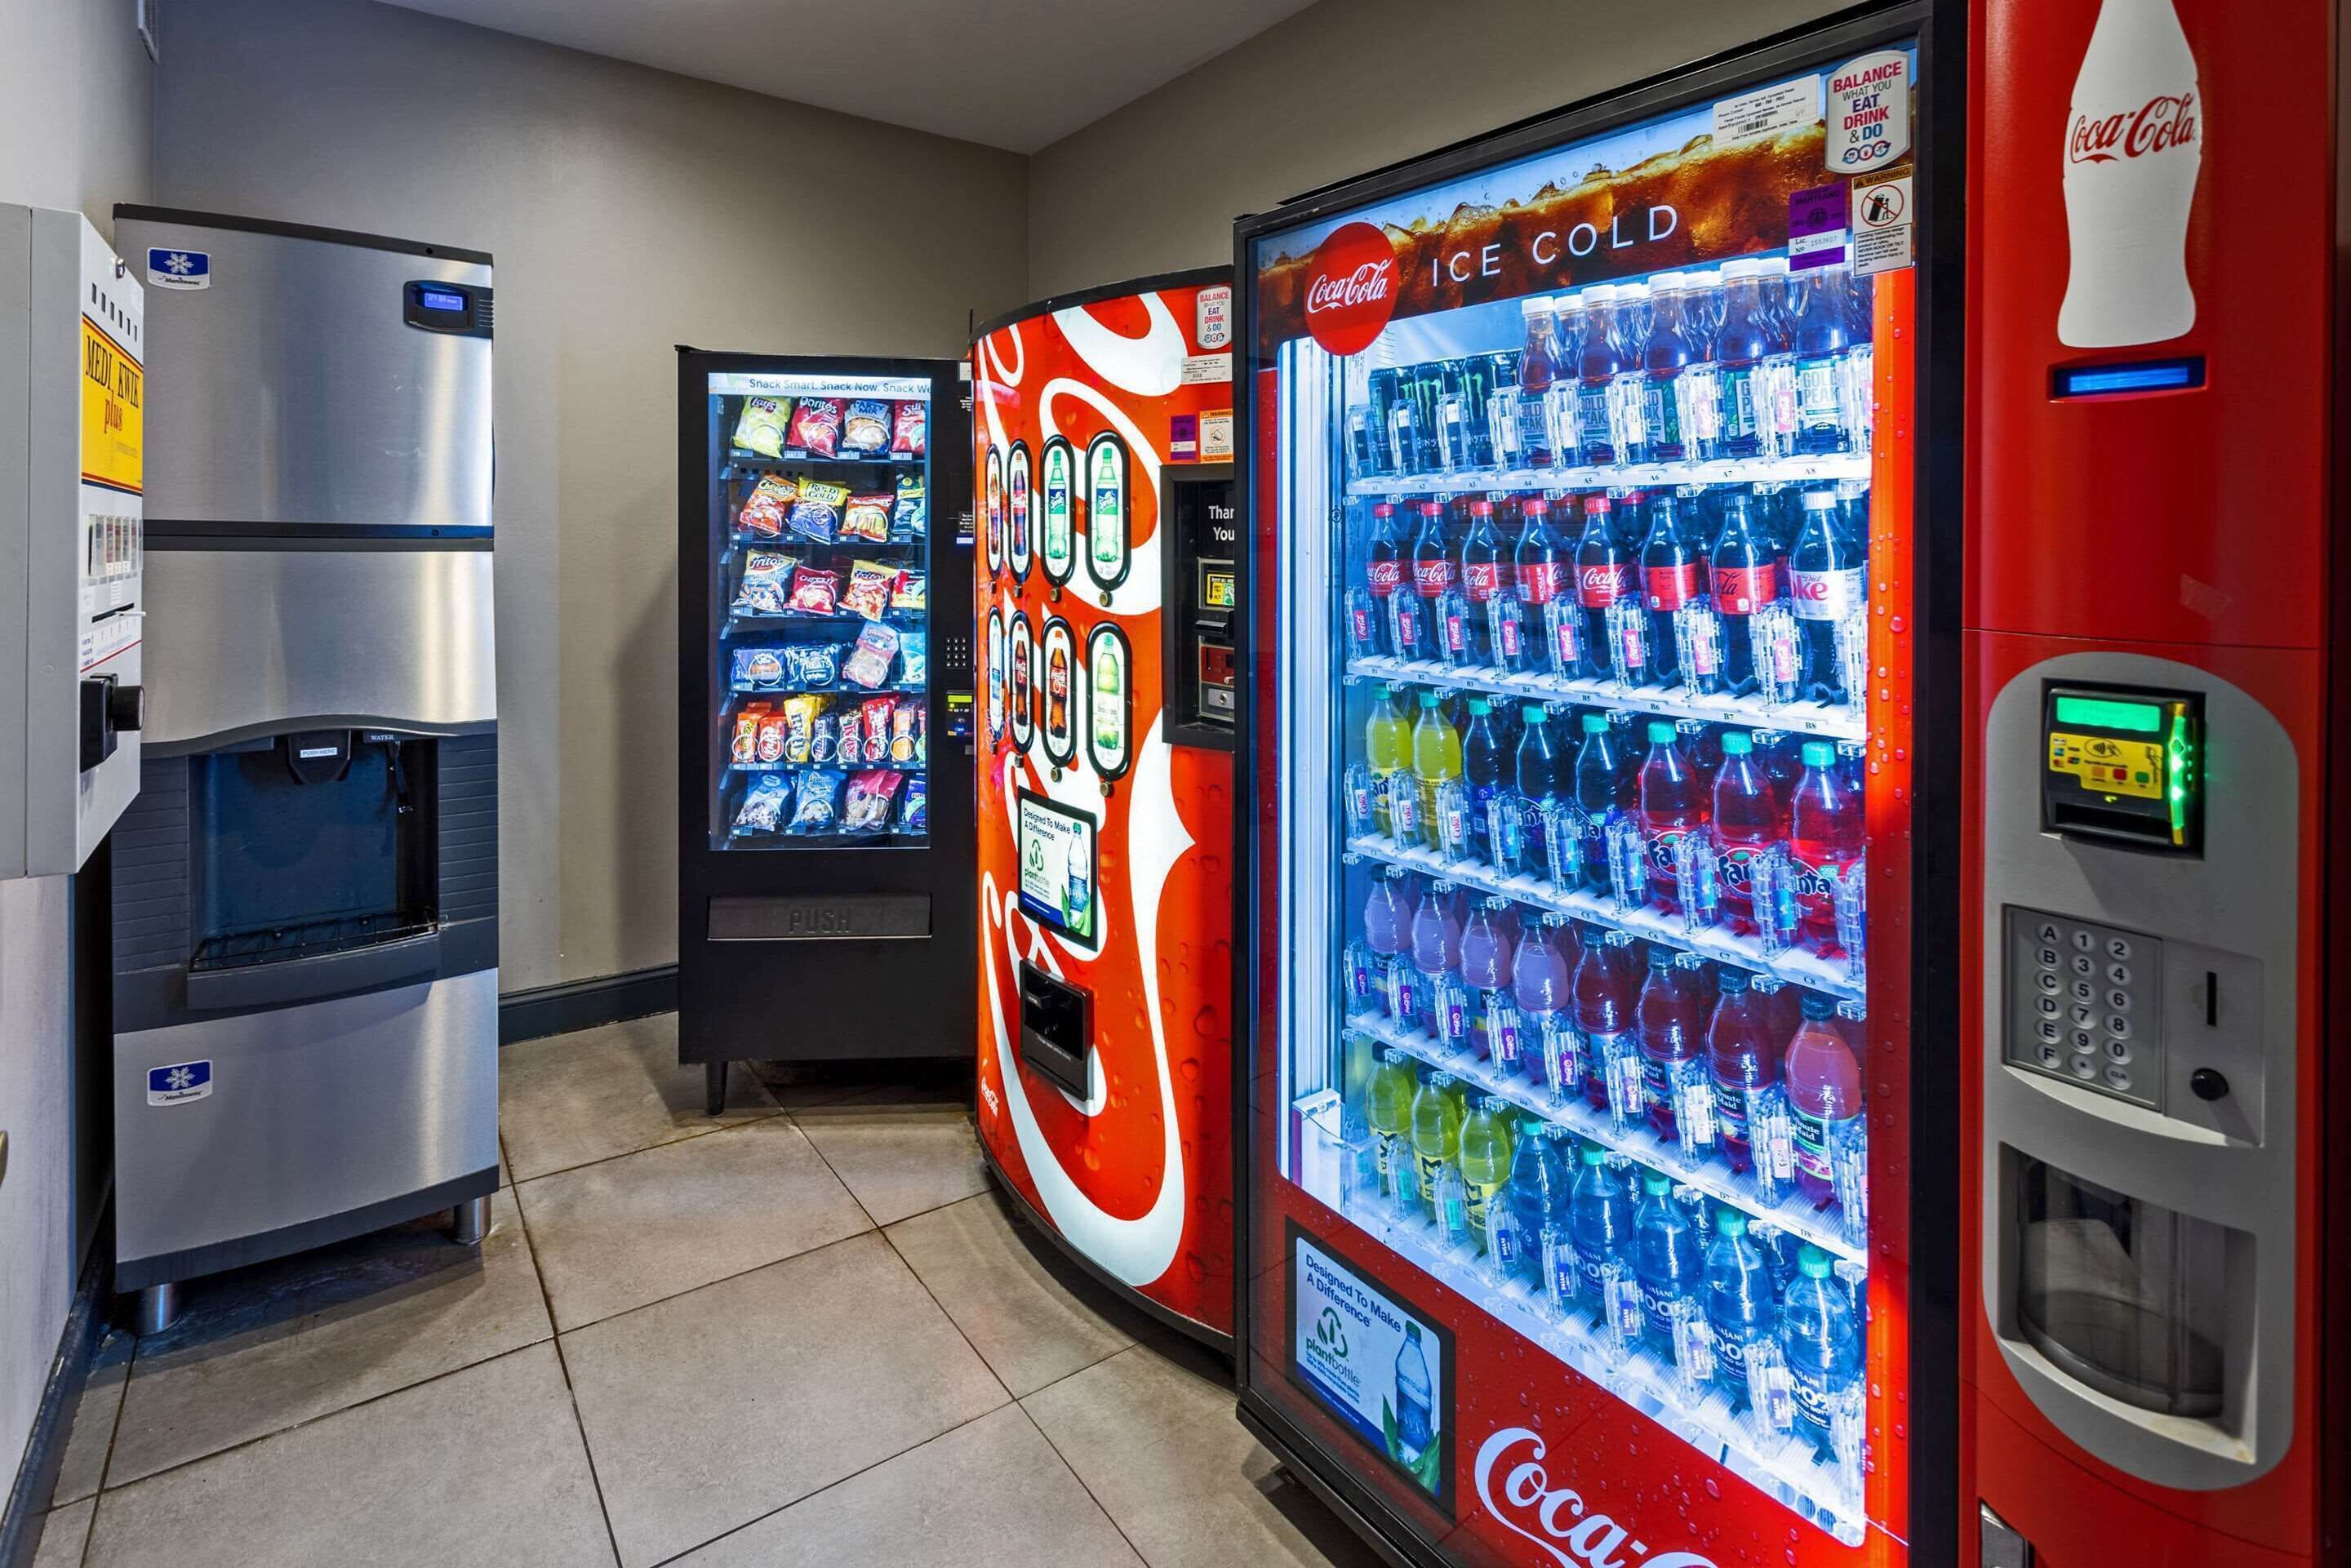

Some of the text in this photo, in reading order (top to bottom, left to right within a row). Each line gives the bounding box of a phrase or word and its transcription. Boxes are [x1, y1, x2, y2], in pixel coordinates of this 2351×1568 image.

[1833, 61, 1902, 93] BALANCE
[1842, 79, 1891, 101] WHAT YOU
[1853, 93, 1880, 113] EAT
[1843, 105, 1890, 131] DRINK
[2070, 92, 2194, 163] Coca-Cola
[1849, 122, 1883, 144] & DO
[1865, 167, 1910, 186] WARNING
[1432, 204, 1679, 287] ICE COLD
[1200, 291, 1229, 303] BALANCE
[1306, 256, 1393, 314] Coca-Cola
[1204, 314, 1224, 325] DRINK
[1208, 307, 1220, 316] EAT
[1212, 322, 1221, 331] DO
[86, 335, 140, 408] MEDI KWIK
[749, 379, 780, 389] Snack
[784, 380, 818, 391] Smart.
[821, 381, 851, 392] Snack
[883, 383, 914, 393] Snack
[104, 389, 123, 433] plus
[800, 396, 837, 415] Doritos
[1213, 526, 1234, 541] You
[1651, 703, 1660, 711] B6
[1723, 713, 1734, 721] B7
[1805, 722, 1816, 730] B8
[1024, 807, 1071, 835] Designed To Make
[1024, 820, 1055, 842] A Difference
[789, 908, 851, 935] PUSH
[2043, 926, 2125, 956] A 1 2
[1647, 931, 1659, 939] C6
[1719, 951, 1731, 960] C7
[1803, 976, 1816, 985] C8
[2044, 950, 2125, 980] B 3 4
[2043, 975, 2125, 1006] C 5 6
[2043, 999, 2125, 1032] D 7 8
[2043, 1024, 2124, 1057] E 9 0
[2043, 1048, 2055, 1061] F
[1306, 1253, 1402, 1333] Designed To Make
[1306, 1273, 1371, 1327] A Difference
[1306, 1336, 1360, 1388] plantbottle
